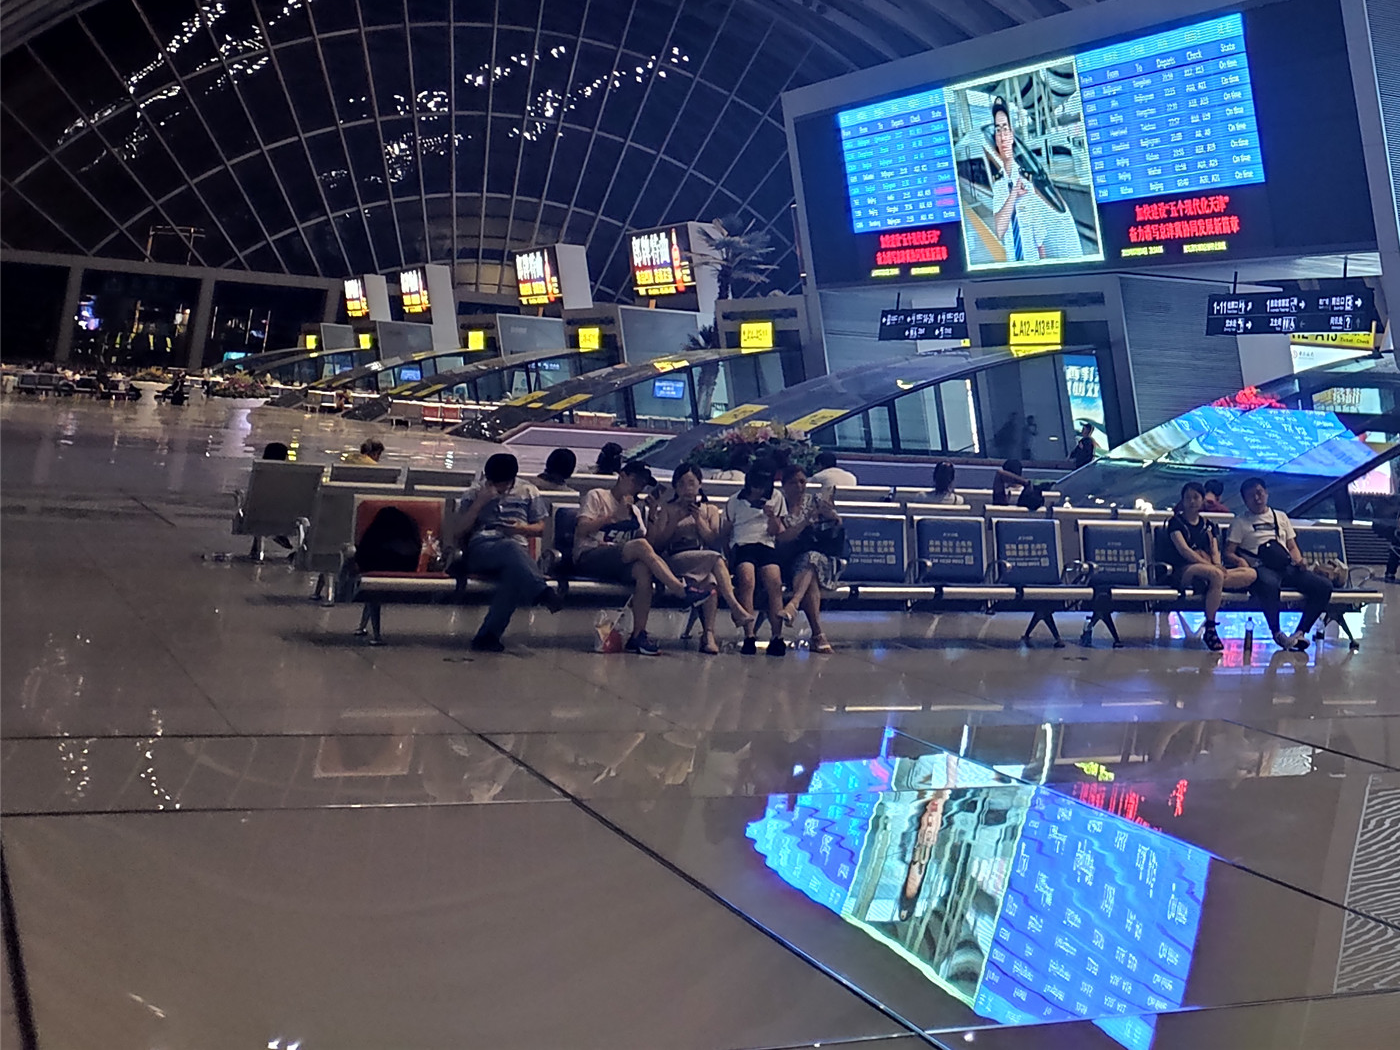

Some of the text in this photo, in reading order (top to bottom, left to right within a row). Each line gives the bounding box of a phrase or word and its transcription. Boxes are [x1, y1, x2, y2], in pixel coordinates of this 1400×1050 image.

[1219, 60, 1226, 69] On
[1232, 155, 1240, 163] On
[1020, 321, 1045, 336] A12-A13
